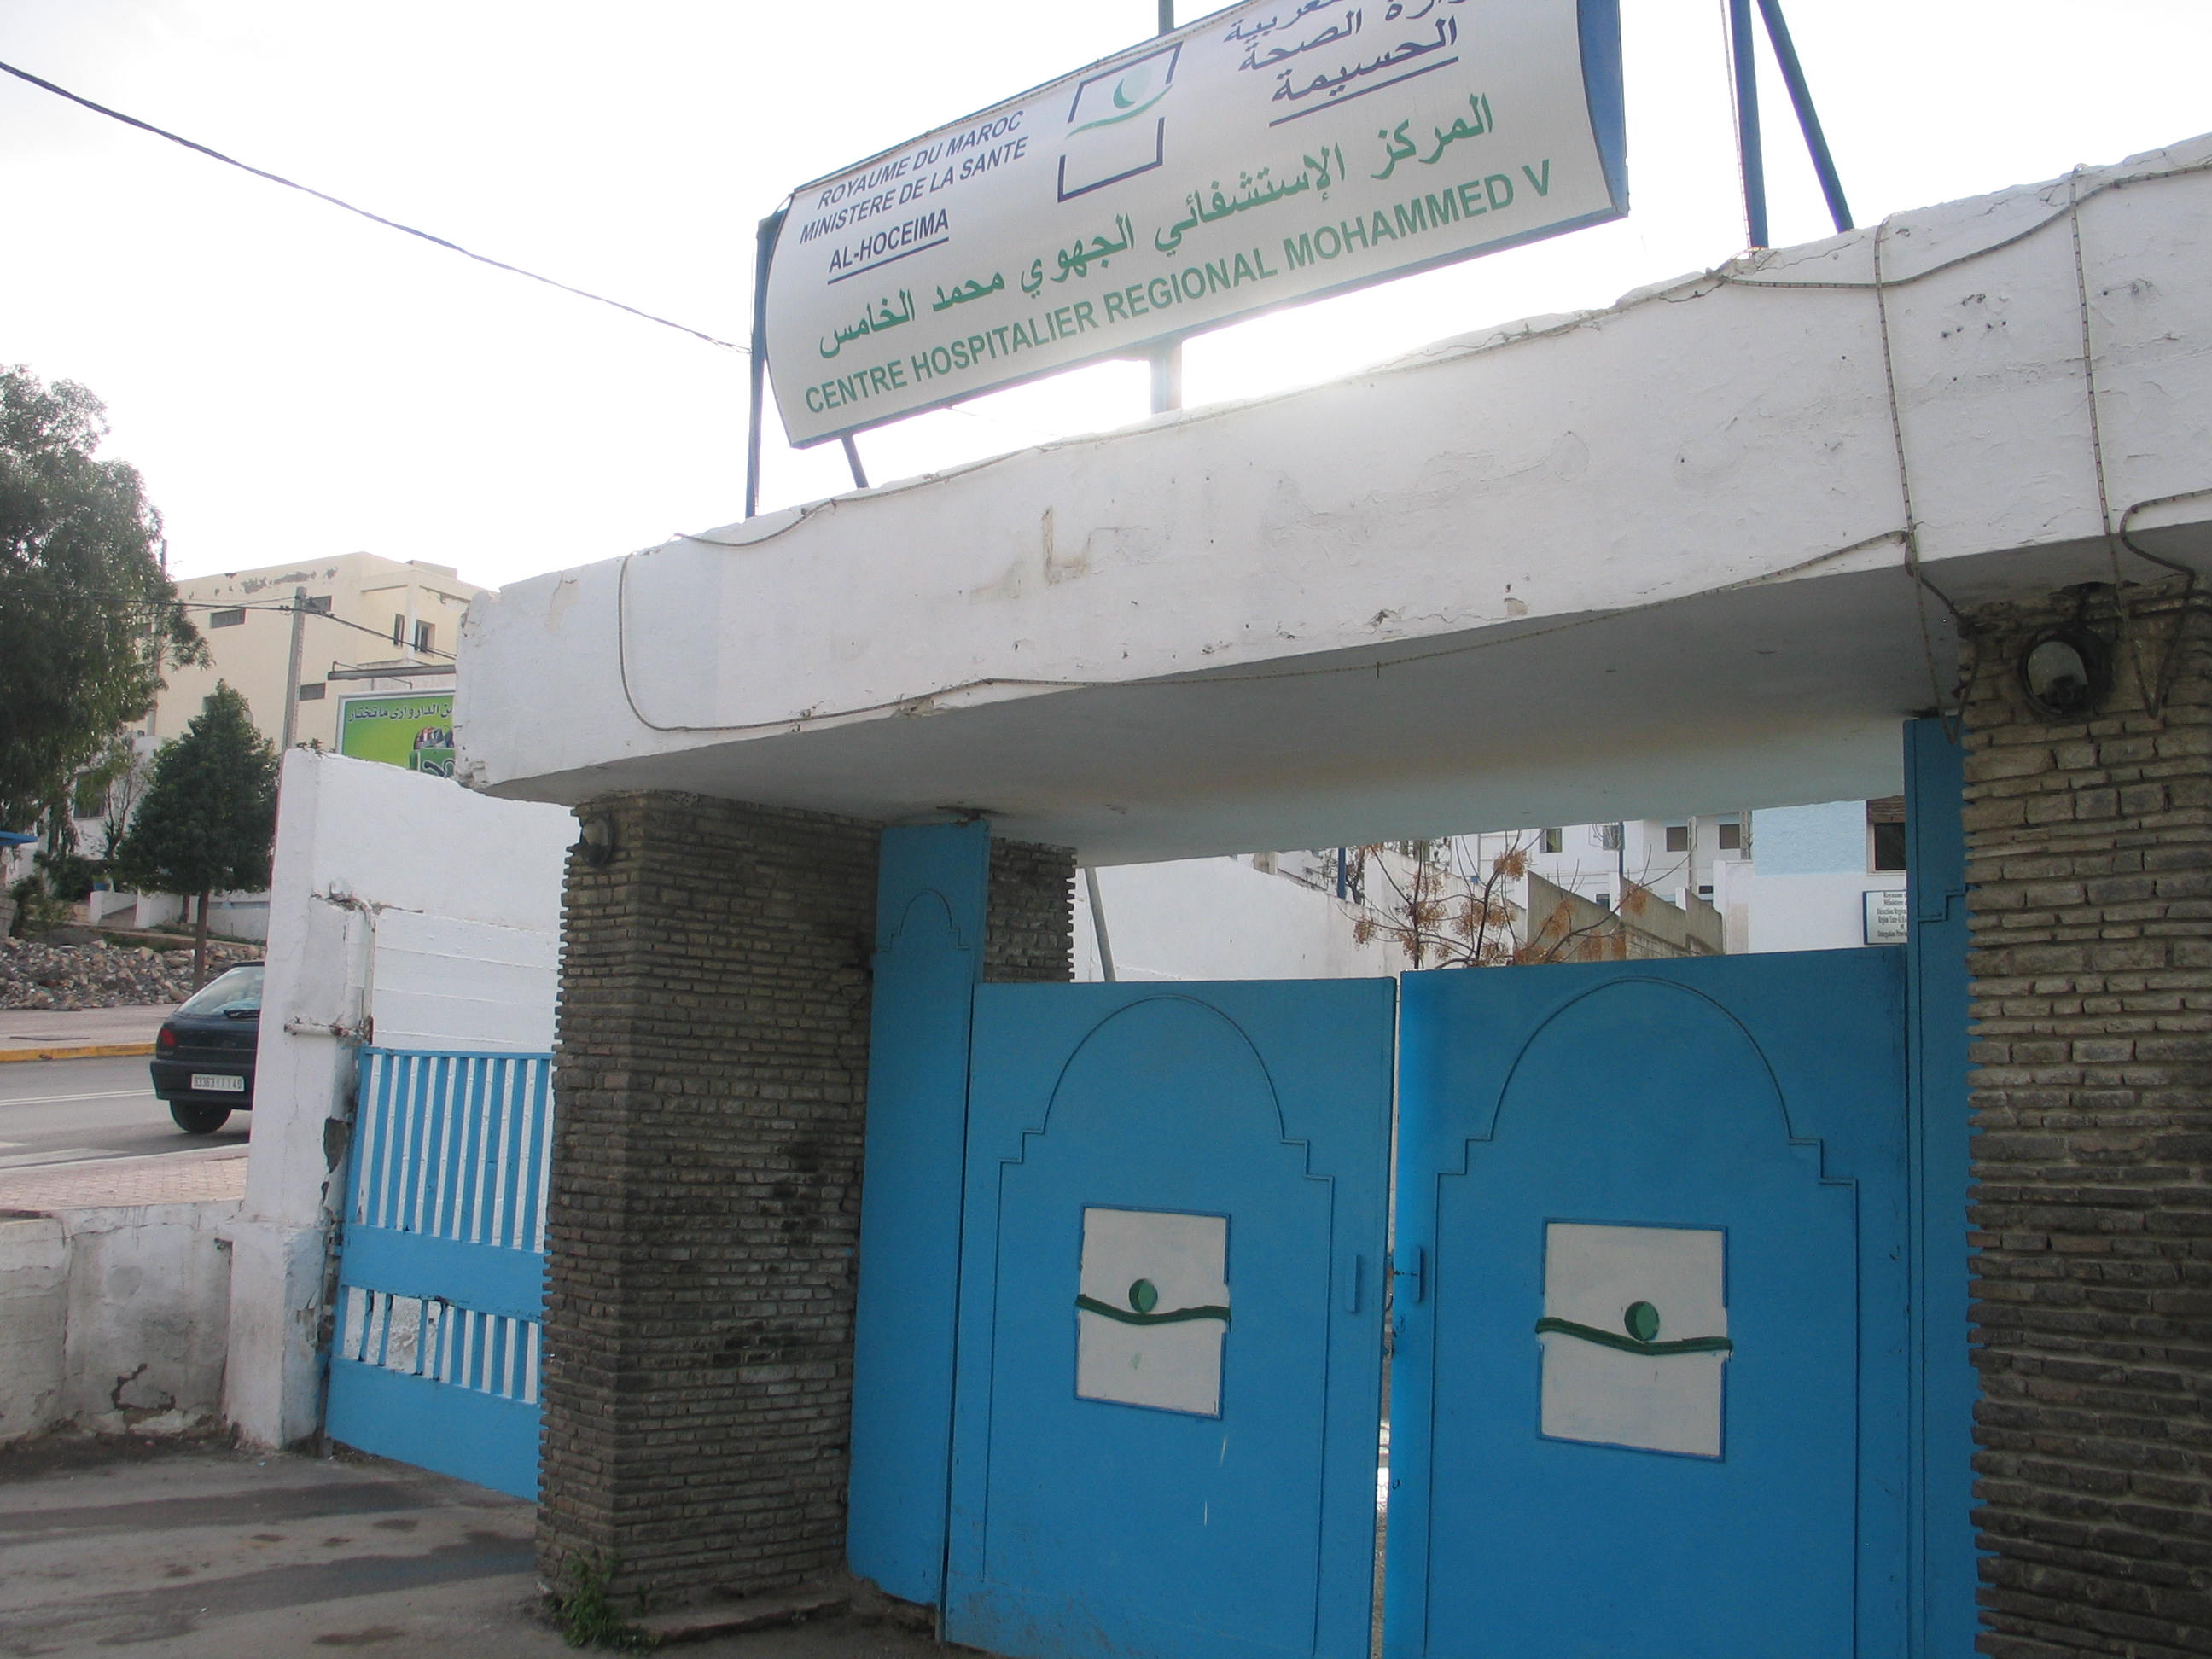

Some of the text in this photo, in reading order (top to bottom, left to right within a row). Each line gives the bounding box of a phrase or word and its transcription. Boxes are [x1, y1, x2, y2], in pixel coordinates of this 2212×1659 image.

[1239, 8, 1362, 71] الصحة
[1272, 15, 1457, 102] الحسيمة
[800, 136, 1028, 245] MINISTERE DE LA SANTE
[818, 110, 1024, 210] ROYAUME DU MAROC
[819, 92, 1493, 358] المركز الإستشفائي الجهوي محمد الخامس
[829, 208, 949, 273] AL-HOCEIMA
[806, 159, 1551, 413] CENTRE HOSPITALIER REGIONAL MOHAMMED V
